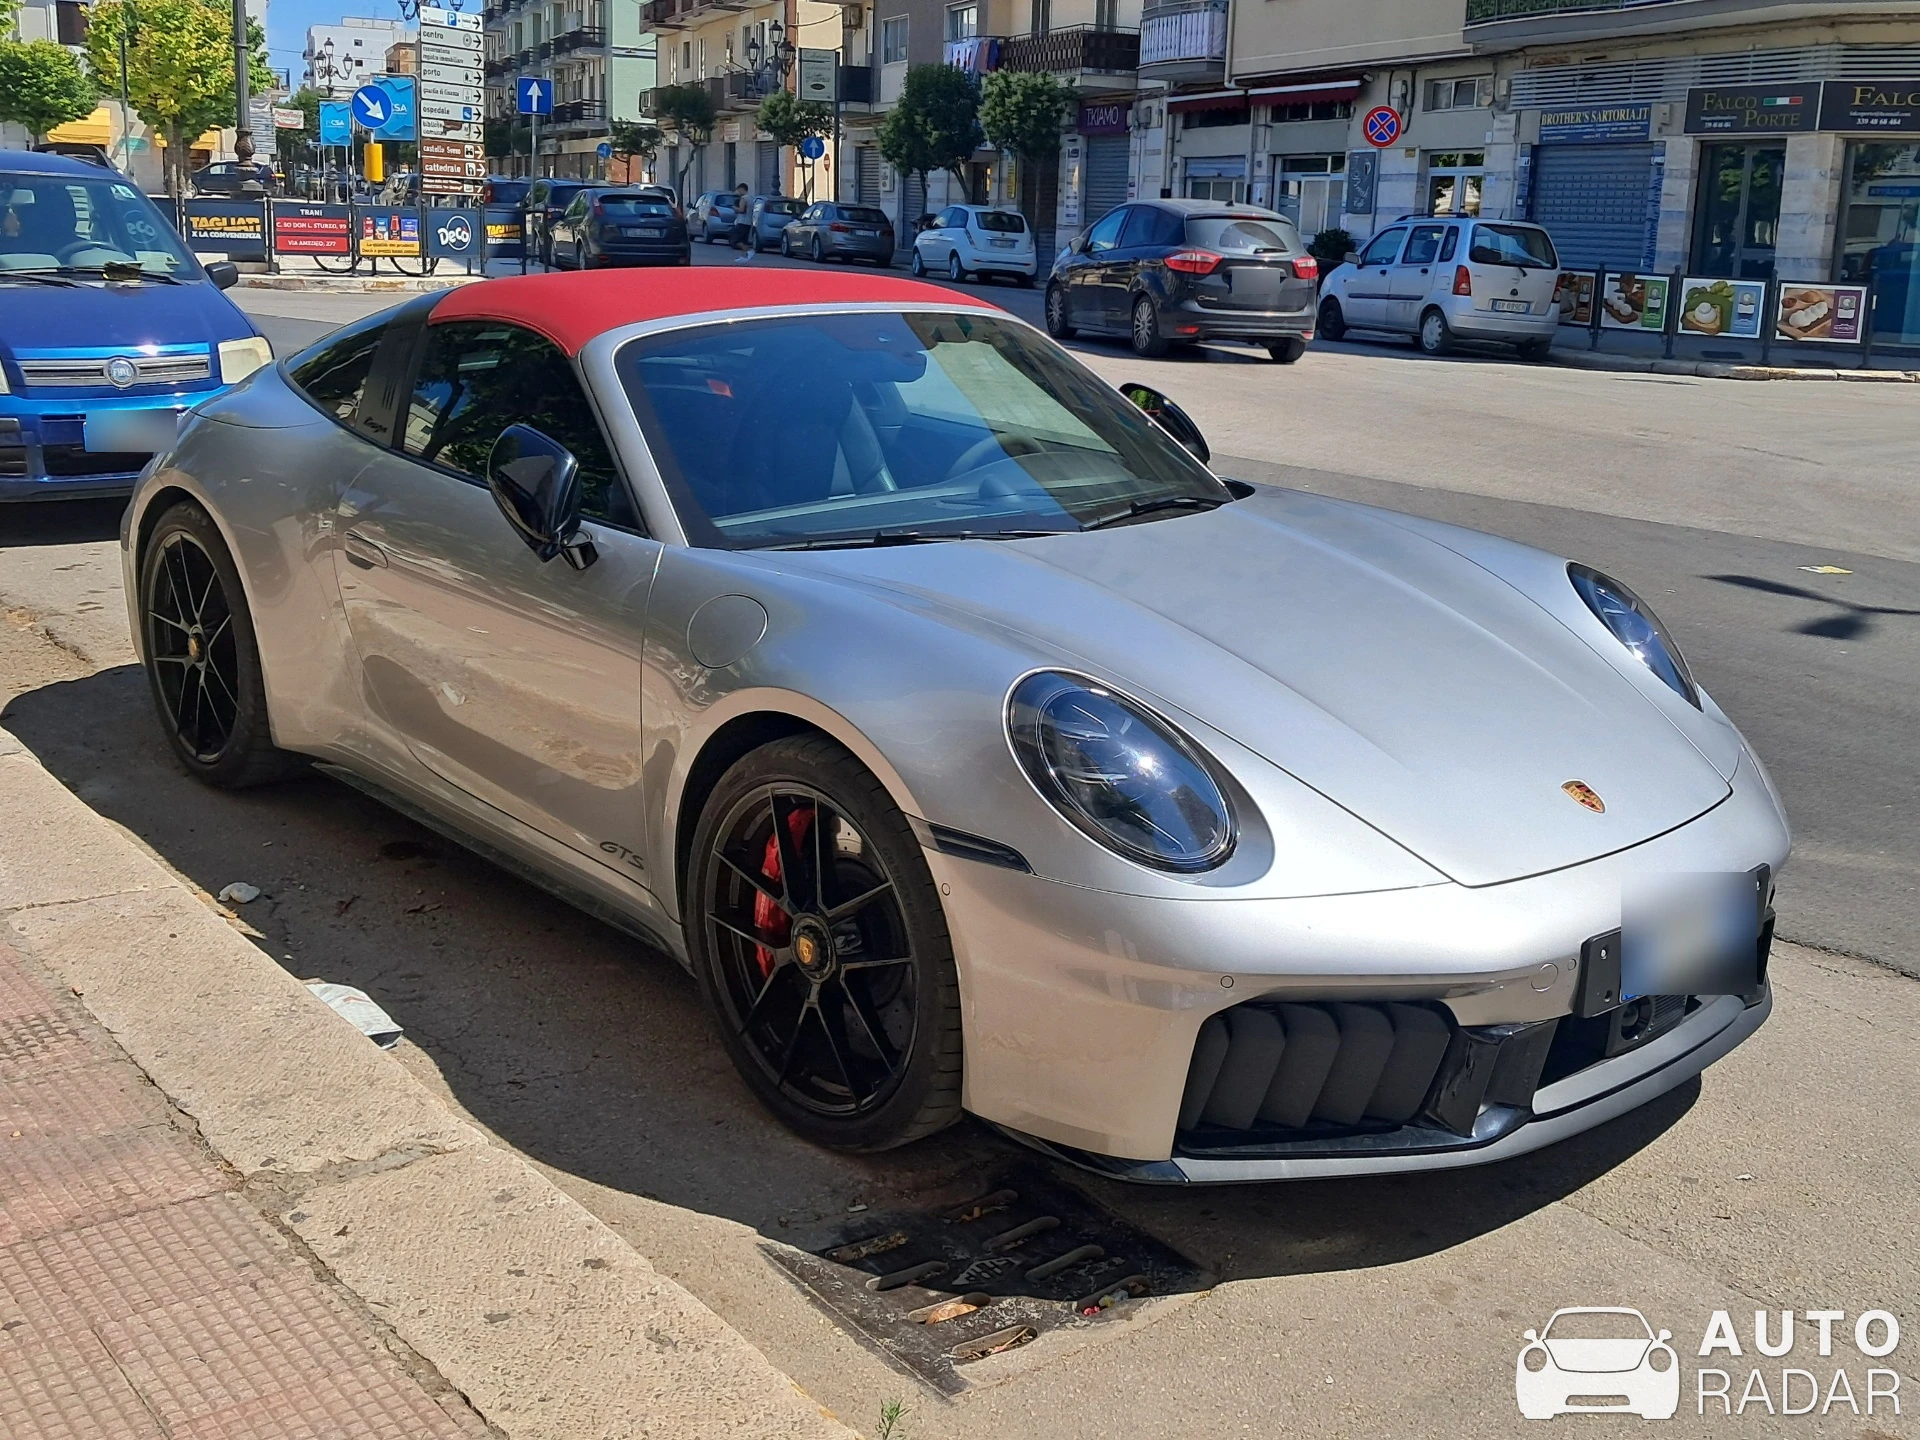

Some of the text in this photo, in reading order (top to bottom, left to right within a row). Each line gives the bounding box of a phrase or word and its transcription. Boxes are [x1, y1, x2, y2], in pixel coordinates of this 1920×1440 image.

[423, 31, 444, 39] centro
[422, 69, 441, 77] porto
[1702, 92, 1757, 111] FALCO
[422, 106, 450, 115] ospedale
[1541, 111, 1589, 126] BROTHER'S
[1744, 110, 1800, 127] PORTE
[424, 163, 461, 173] cattedrale
[190, 217, 262, 232] TAGLIATI
[209, 231, 262, 240] CONVENIENZA
[599, 841, 645, 870] GTS
